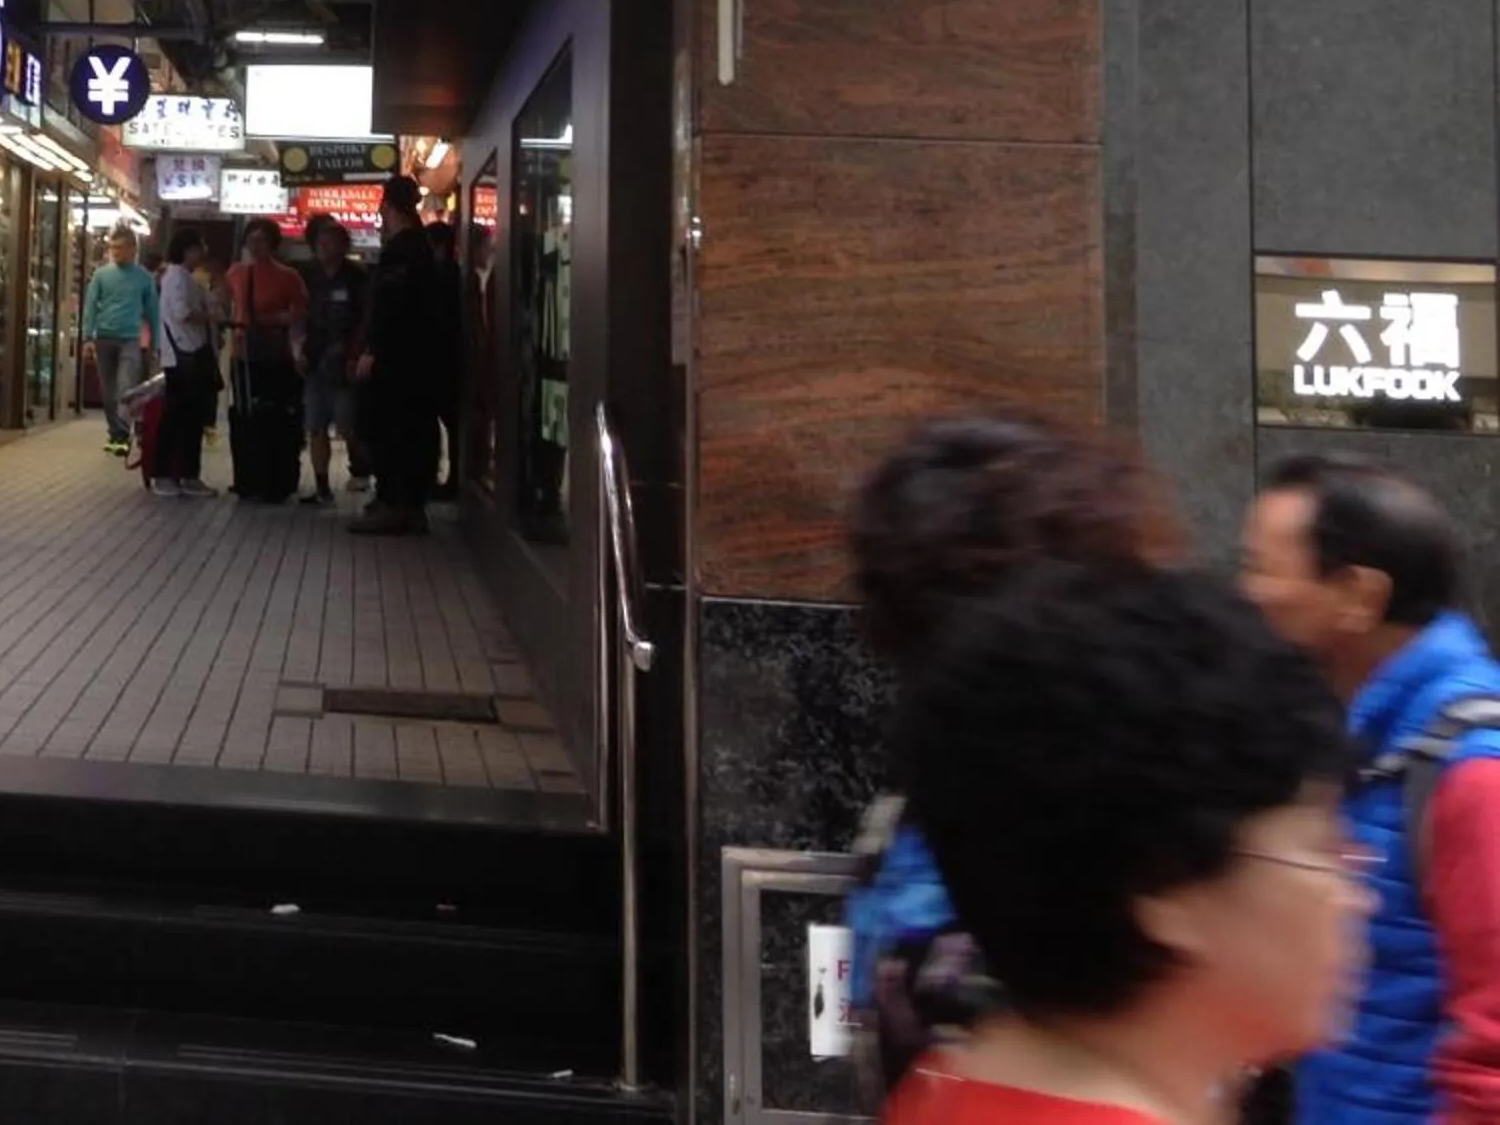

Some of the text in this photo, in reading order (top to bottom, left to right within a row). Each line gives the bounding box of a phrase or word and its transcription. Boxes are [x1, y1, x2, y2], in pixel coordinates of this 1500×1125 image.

[128, 122, 240, 139] SATETES
[1294, 288, 1461, 369] 六福
[1292, 364, 1462, 402] LUKFOOK
